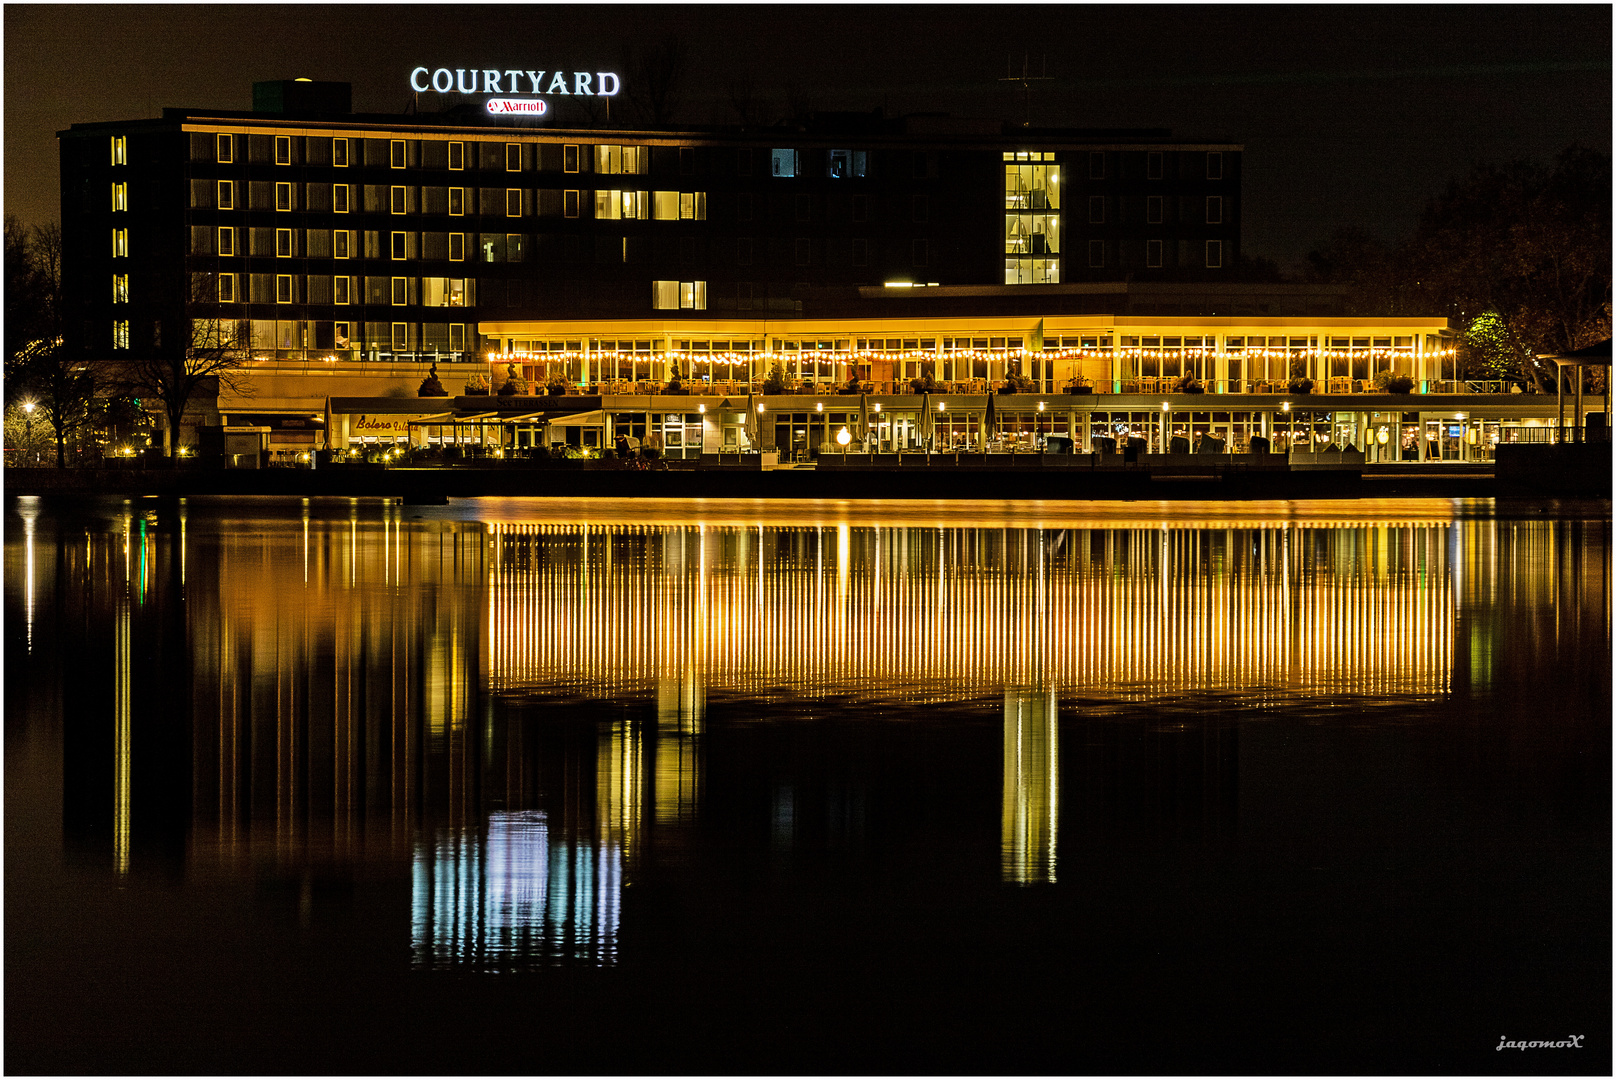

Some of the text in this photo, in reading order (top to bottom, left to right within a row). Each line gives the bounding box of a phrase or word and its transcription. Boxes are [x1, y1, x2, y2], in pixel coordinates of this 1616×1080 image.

[410, 66, 620, 96] COURTYARD
[500, 101, 543, 112] Marriott
[356, 416, 392, 430] Bolero
